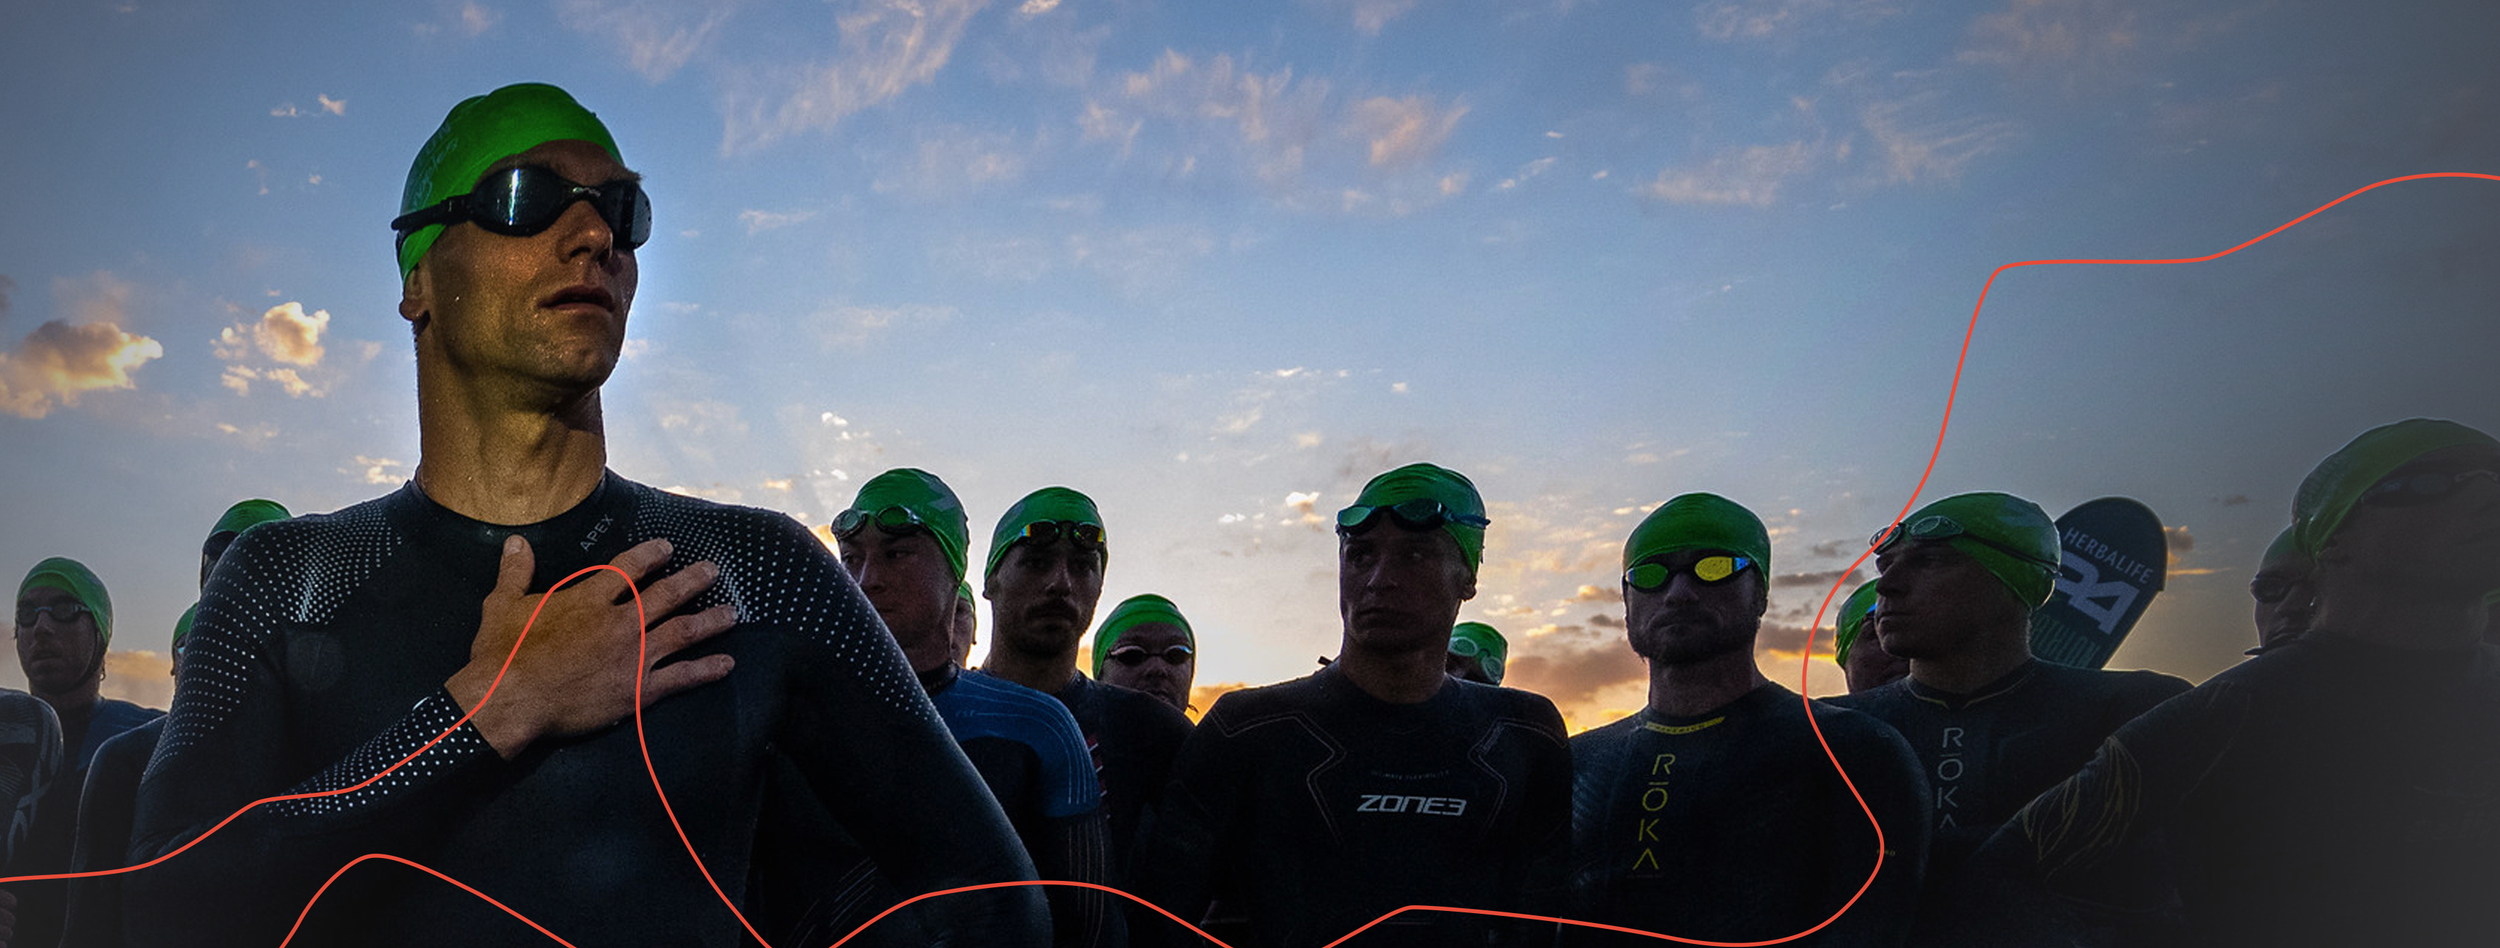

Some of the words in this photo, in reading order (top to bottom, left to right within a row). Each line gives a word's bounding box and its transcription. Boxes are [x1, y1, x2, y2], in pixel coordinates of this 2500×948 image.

[580, 514, 614, 552] APEX
[2063, 526, 2154, 584] HERBALIFE
[1356, 794, 1468, 817] ZONE3
